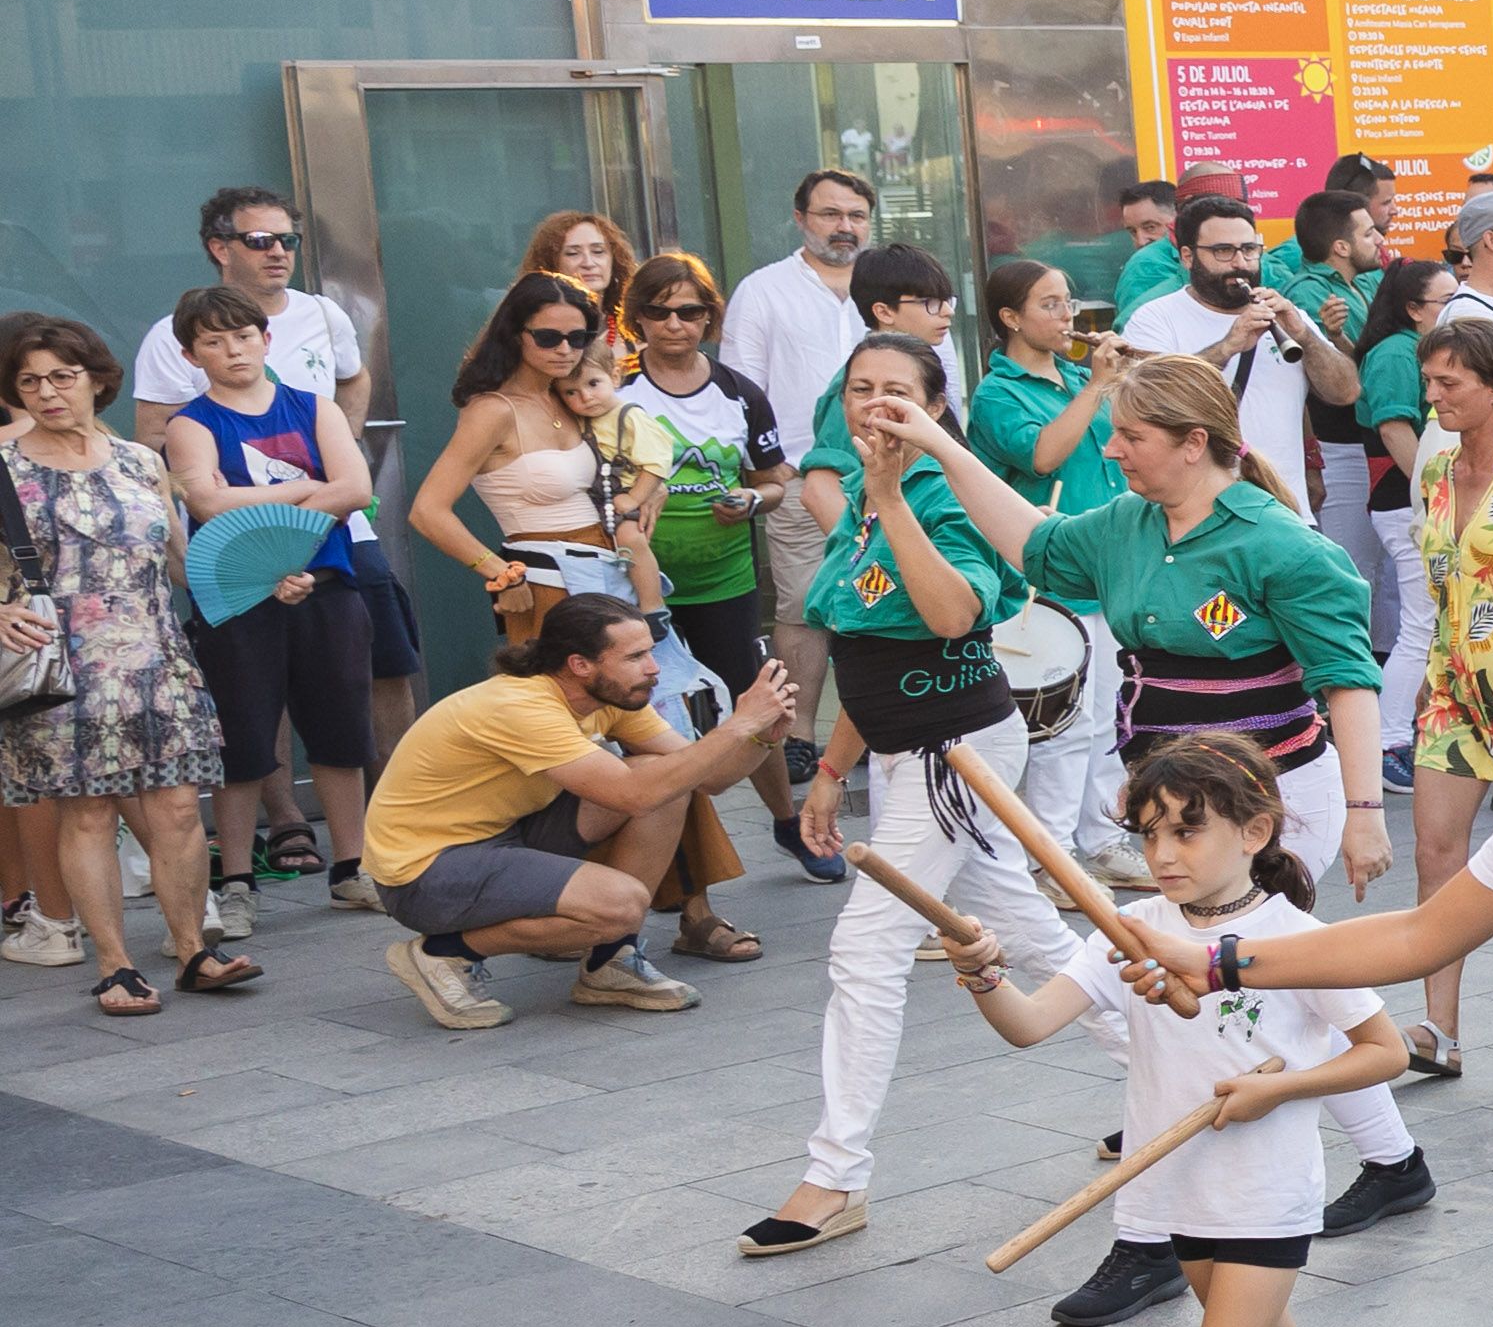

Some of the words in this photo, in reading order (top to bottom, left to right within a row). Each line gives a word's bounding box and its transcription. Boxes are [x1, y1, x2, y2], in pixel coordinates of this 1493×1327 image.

[1177, 66, 1186, 83] 5
[1189, 66, 1207, 83] DE
[1210, 65, 1253, 83] JULIOL
[1211, 100, 1227, 112] DE
[1274, 99, 1290, 111] DE
[1394, 159, 1431, 176] JULIOL
